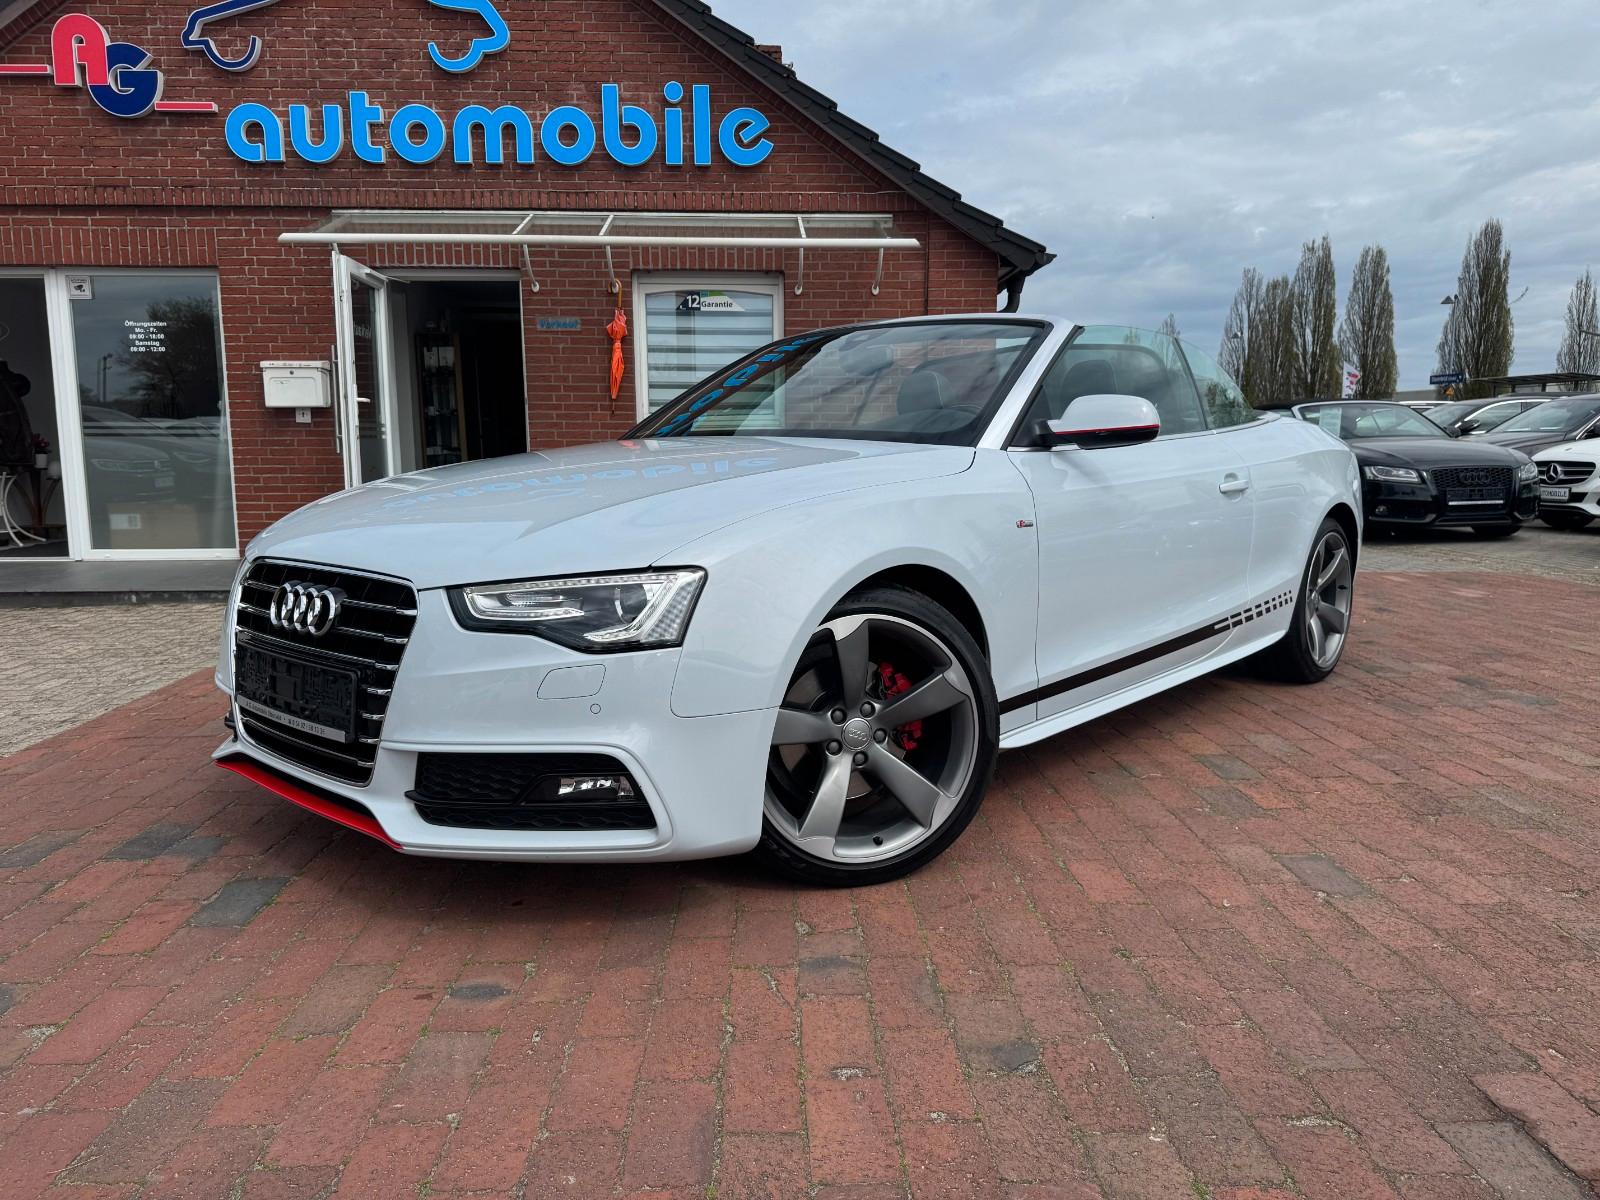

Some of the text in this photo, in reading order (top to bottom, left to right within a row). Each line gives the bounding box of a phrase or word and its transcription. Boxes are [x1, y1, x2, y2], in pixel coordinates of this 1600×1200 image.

[51, 13, 163, 118] AG
[225, 80, 775, 167] automobile
[686, 295, 733, 308] 12 Garantie
